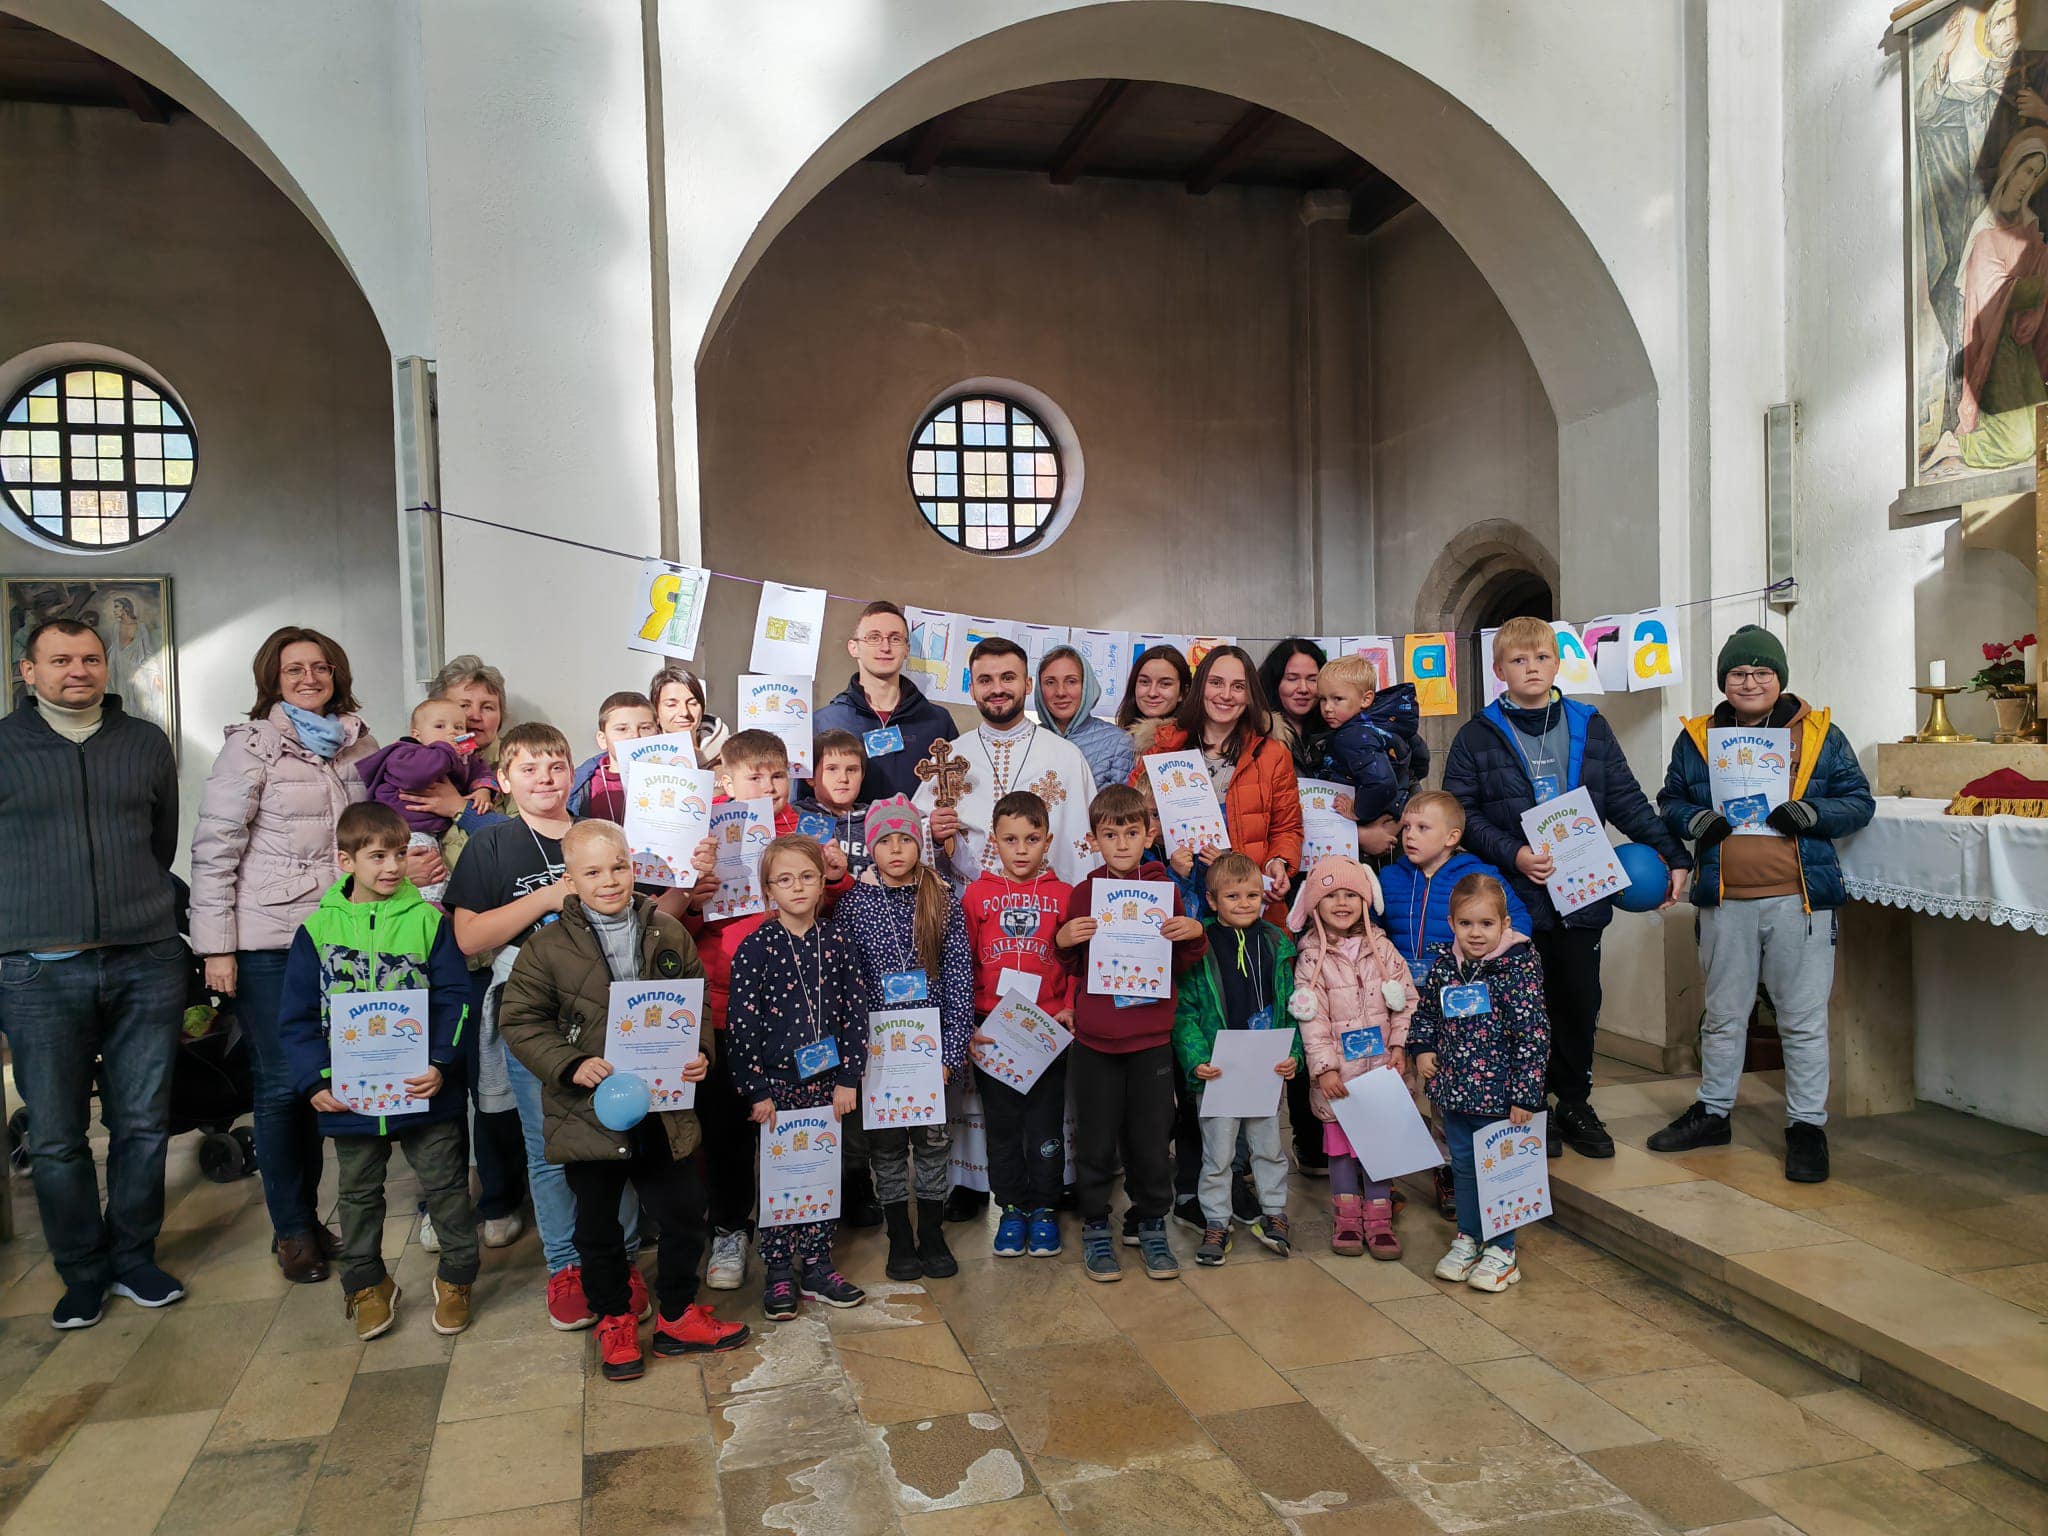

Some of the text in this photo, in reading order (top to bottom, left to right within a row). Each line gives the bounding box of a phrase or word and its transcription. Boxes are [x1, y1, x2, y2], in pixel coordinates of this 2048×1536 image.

[752, 683, 798, 697] ДИПЛОМ
[630, 743, 679, 761] ДИПЛОМ
[1721, 735, 1775, 751] ДИПЛОМ
[1158, 760, 1194, 775] ДИПЛОМ
[644, 774, 698, 792] ДИПЛОМ
[709, 811, 758, 830] ДИПЛОМ
[1537, 807, 1578, 835] ДИПЛОМ
[1107, 889, 1159, 904] ДИПЛОМ
[627, 991, 686, 1009] ДИПЛОМ
[348, 1001, 410, 1019] ДИПЛОМ
[1015, 1002, 1057, 1036] ДИПЛОМ
[874, 1019, 925, 1035] ДИПЛОМ
[776, 1117, 828, 1136] ДИПЛОМ
[1485, 1125, 1531, 1149] ДИПЛОМ
